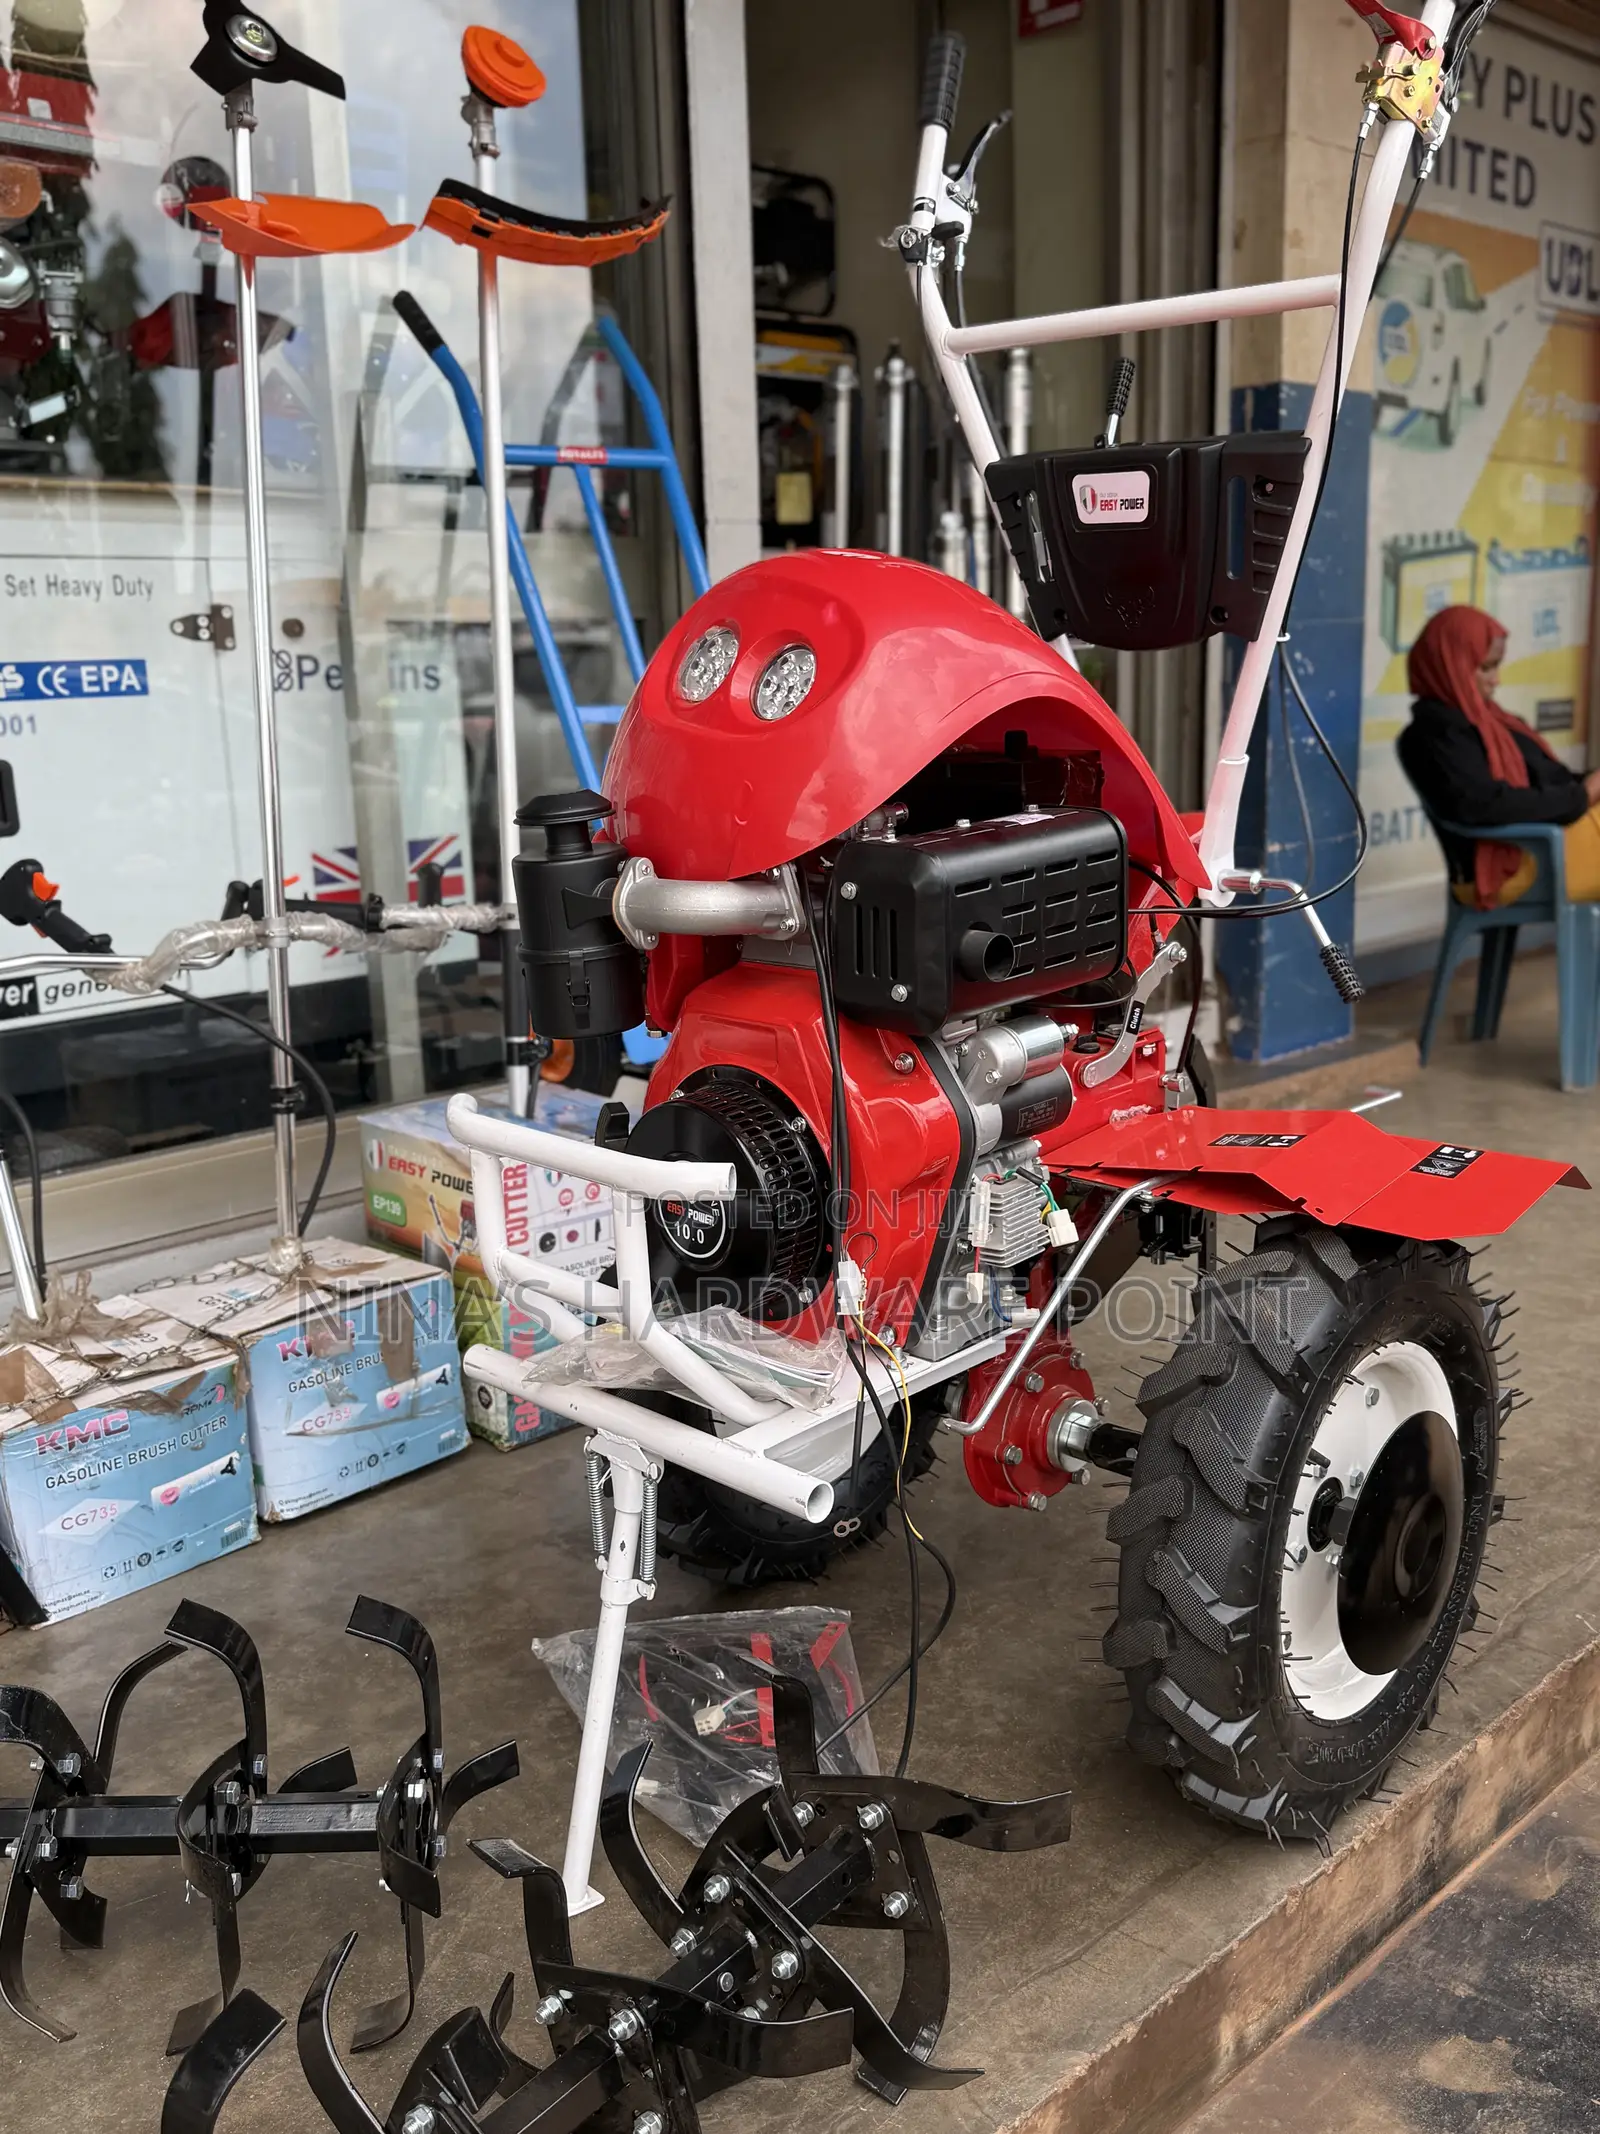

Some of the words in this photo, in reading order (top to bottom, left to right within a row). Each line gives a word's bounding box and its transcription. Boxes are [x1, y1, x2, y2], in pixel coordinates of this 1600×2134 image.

[1503, 63, 1598, 147] PLUS
[1100, 499, 1118, 511] EASY
[1119, 497, 1145, 511] POWER
[5, 573, 37, 598] Set
[46, 573, 102, 603] Heavy
[112, 574, 154, 602] Duty
[80, 663, 142, 693] EPA
[1129, 1007, 1141, 1030] Clutch
[388, 1155, 427, 1179] EASY
[431, 1169, 475, 1196] POWE
[373, 1194, 403, 1217] EP139
[503, 1162, 530, 1247] CUTTER
[667, 1201, 686, 1217] EASY
[687, 1208, 715, 1227] POWER
[674, 1221, 705, 1244] 10.0
[288, 1363, 353, 1393] GASOLINE
[35, 1410, 130, 1456] KMC
[45, 1456, 123, 1489] GASOLINE
[128, 1436, 177, 1466] BRUSH
[180, 1415, 228, 1446] CUTTER
[61, 1504, 118, 1531] CG735
